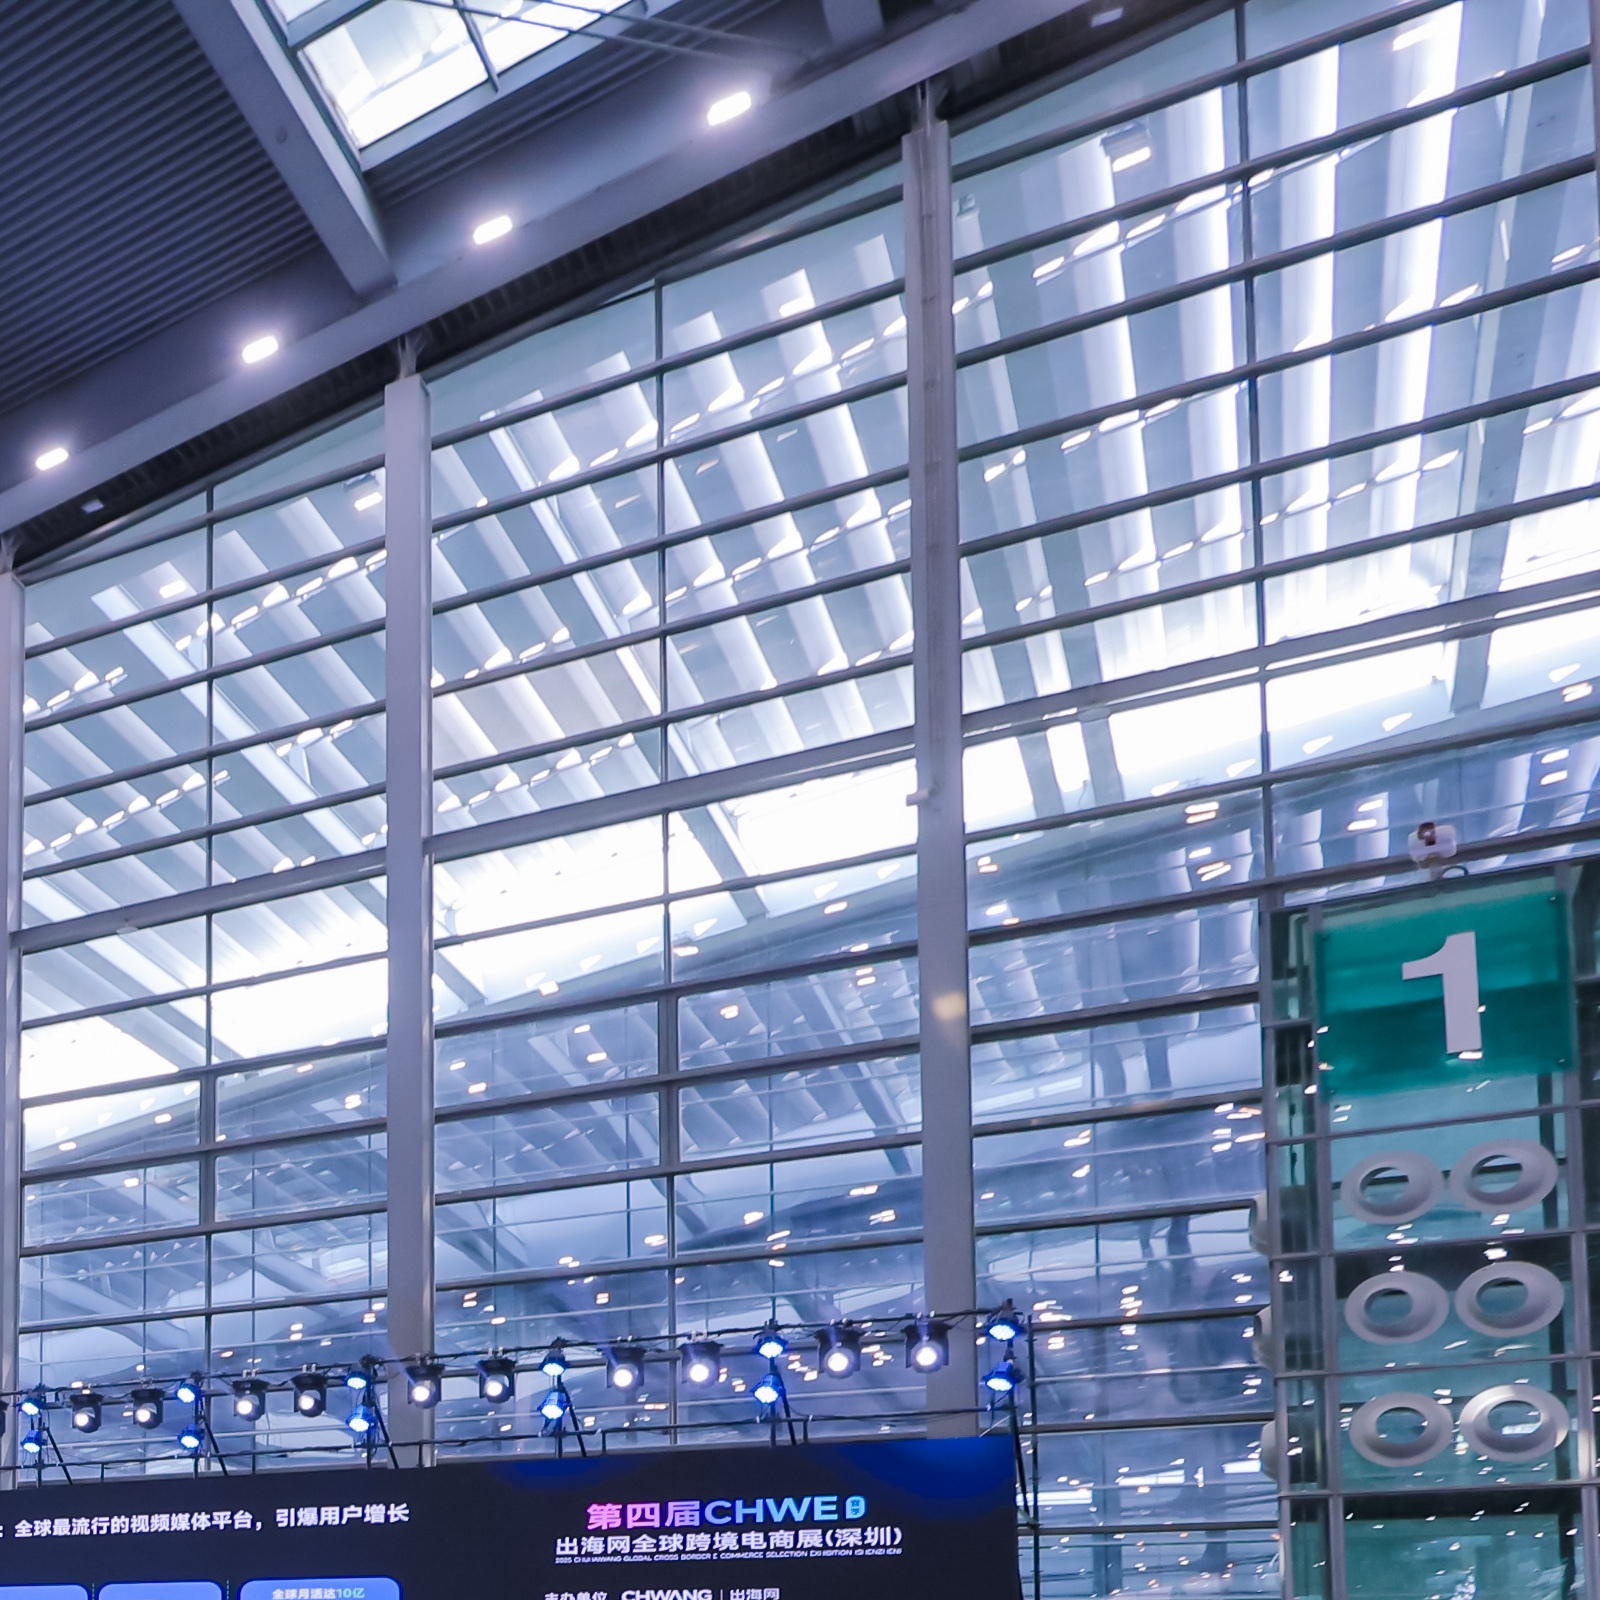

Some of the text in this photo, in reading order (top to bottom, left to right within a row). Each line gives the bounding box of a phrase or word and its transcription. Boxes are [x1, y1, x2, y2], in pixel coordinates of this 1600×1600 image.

[1402, 931, 1481, 1053] 1
[587, 1496, 837, 1530] 第四届CHWE
[556, 1527, 902, 1555] 出海网全球跨境电商展(深圳)
[272, 1588, 365, 1600] 全球月活达10亿
